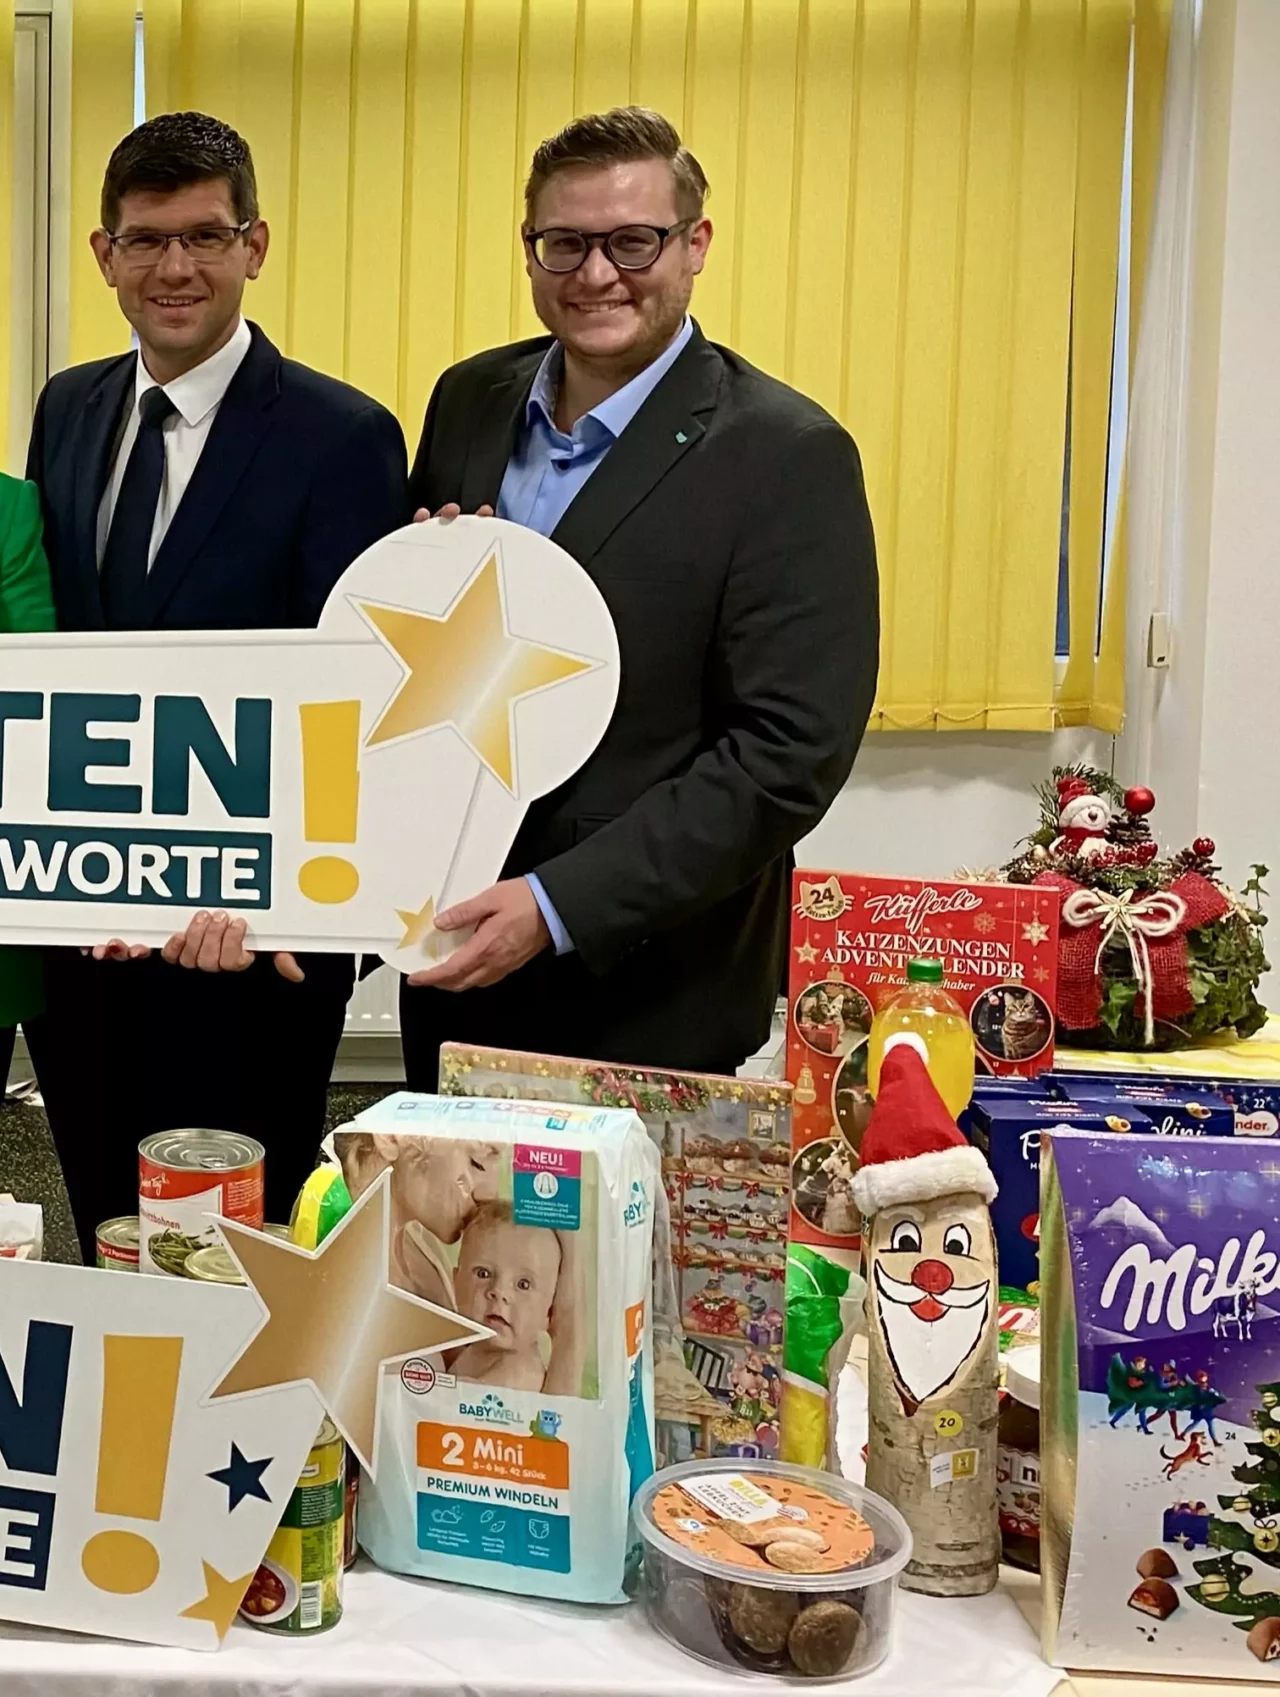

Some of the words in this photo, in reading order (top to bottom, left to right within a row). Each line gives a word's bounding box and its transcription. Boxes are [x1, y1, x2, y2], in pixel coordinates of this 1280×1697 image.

[810, 887, 835, 904] 24
[864, 887, 983, 934] Küfferle
[837, 930, 1011, 959] KATZENZUNGEN
[821, 947, 1026, 979] ADVENTLENDER
[866, 972, 885, 985] für
[1253, 1098, 1265, 1109] 22
[529, 1150, 563, 1166] NEU!
[1100, 1229, 1280, 1331] Milk
[939, 1417, 956, 1428] 20
[1226, 1432, 1237, 1440] 24
[441, 1432, 465, 1466] 2
[473, 1437, 523, 1466] Mini
[427, 1476, 491, 1498] PREMIUM
[494, 1487, 559, 1509] WINDELN
